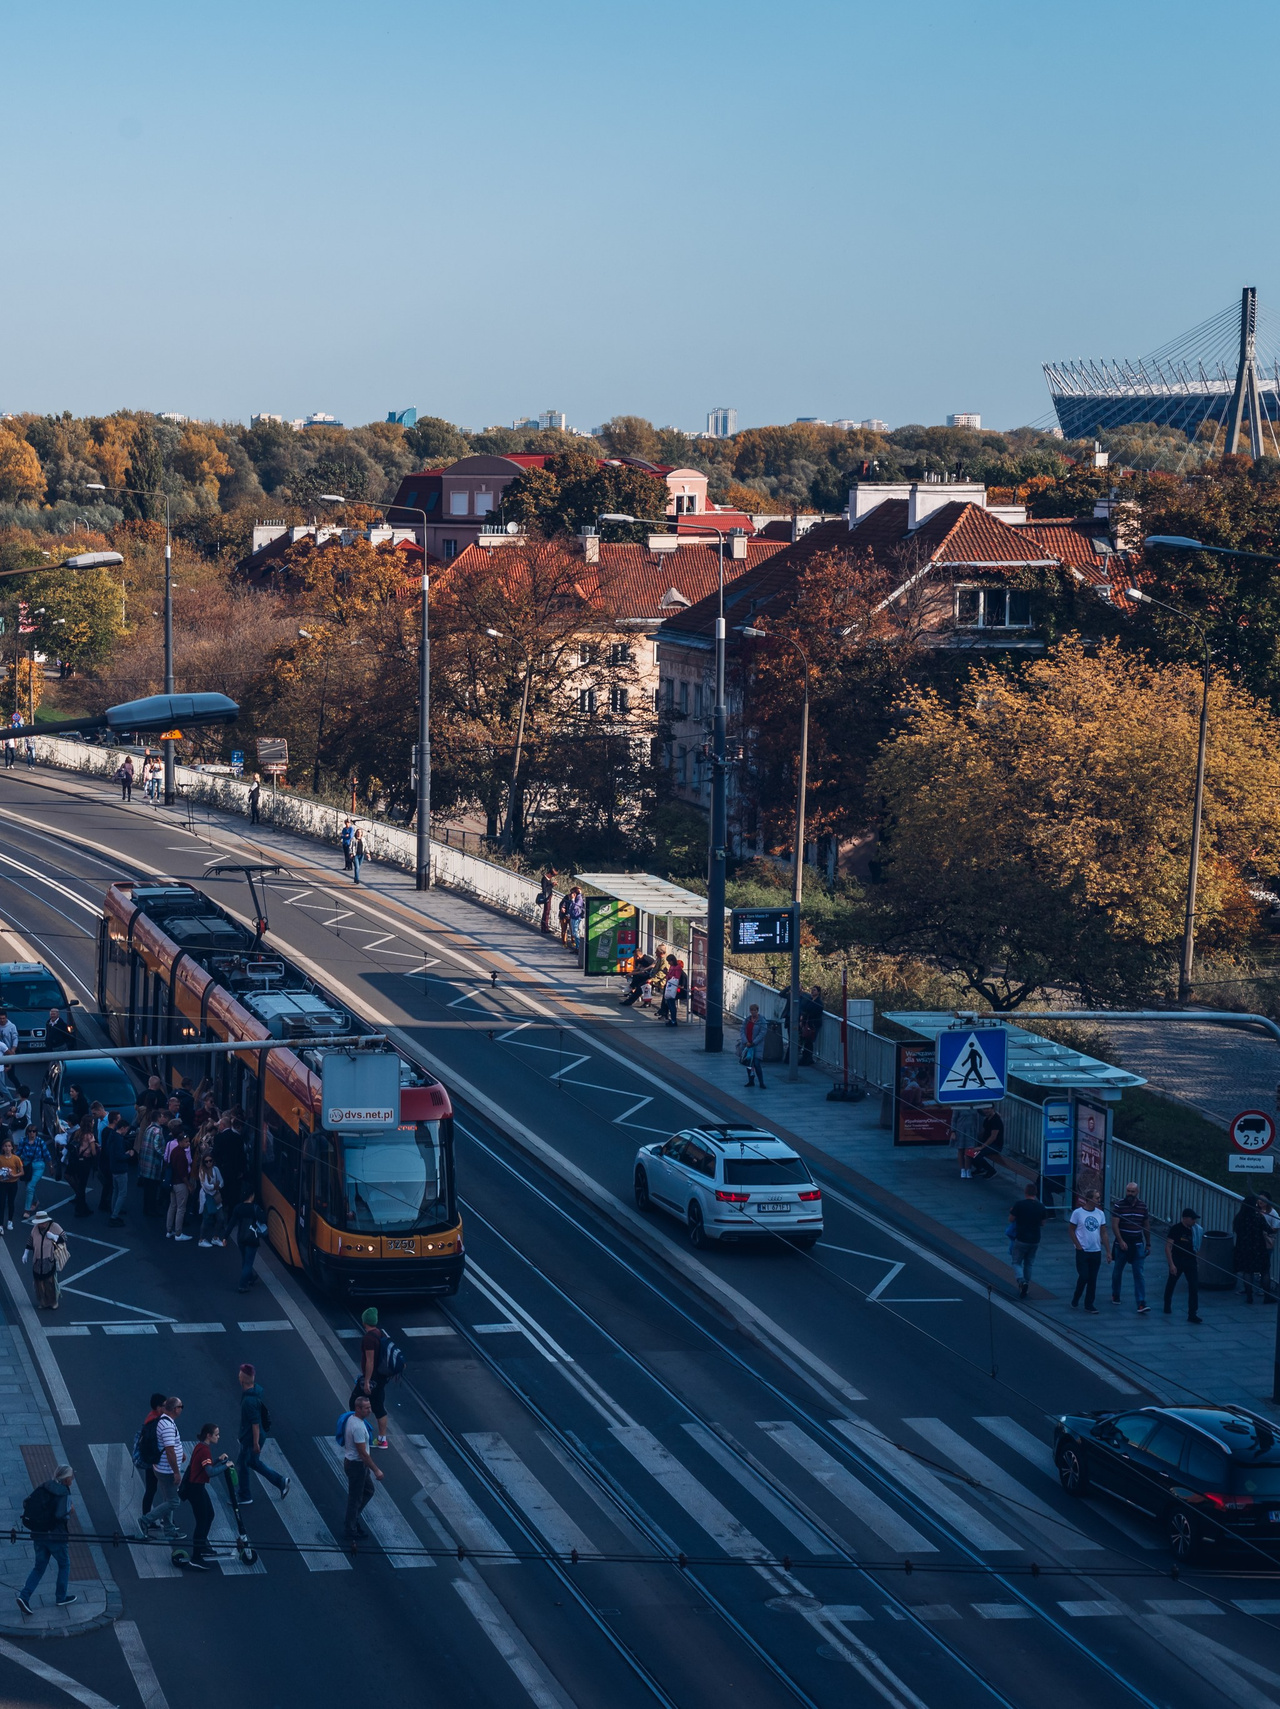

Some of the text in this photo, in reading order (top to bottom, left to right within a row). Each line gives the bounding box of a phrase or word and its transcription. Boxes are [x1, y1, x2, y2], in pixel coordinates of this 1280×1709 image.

[344, 1110, 392, 1121] dvs.net.pl
[1243, 1134, 1259, 1146] 2,5
[387, 1240, 415, 1250] 3250
